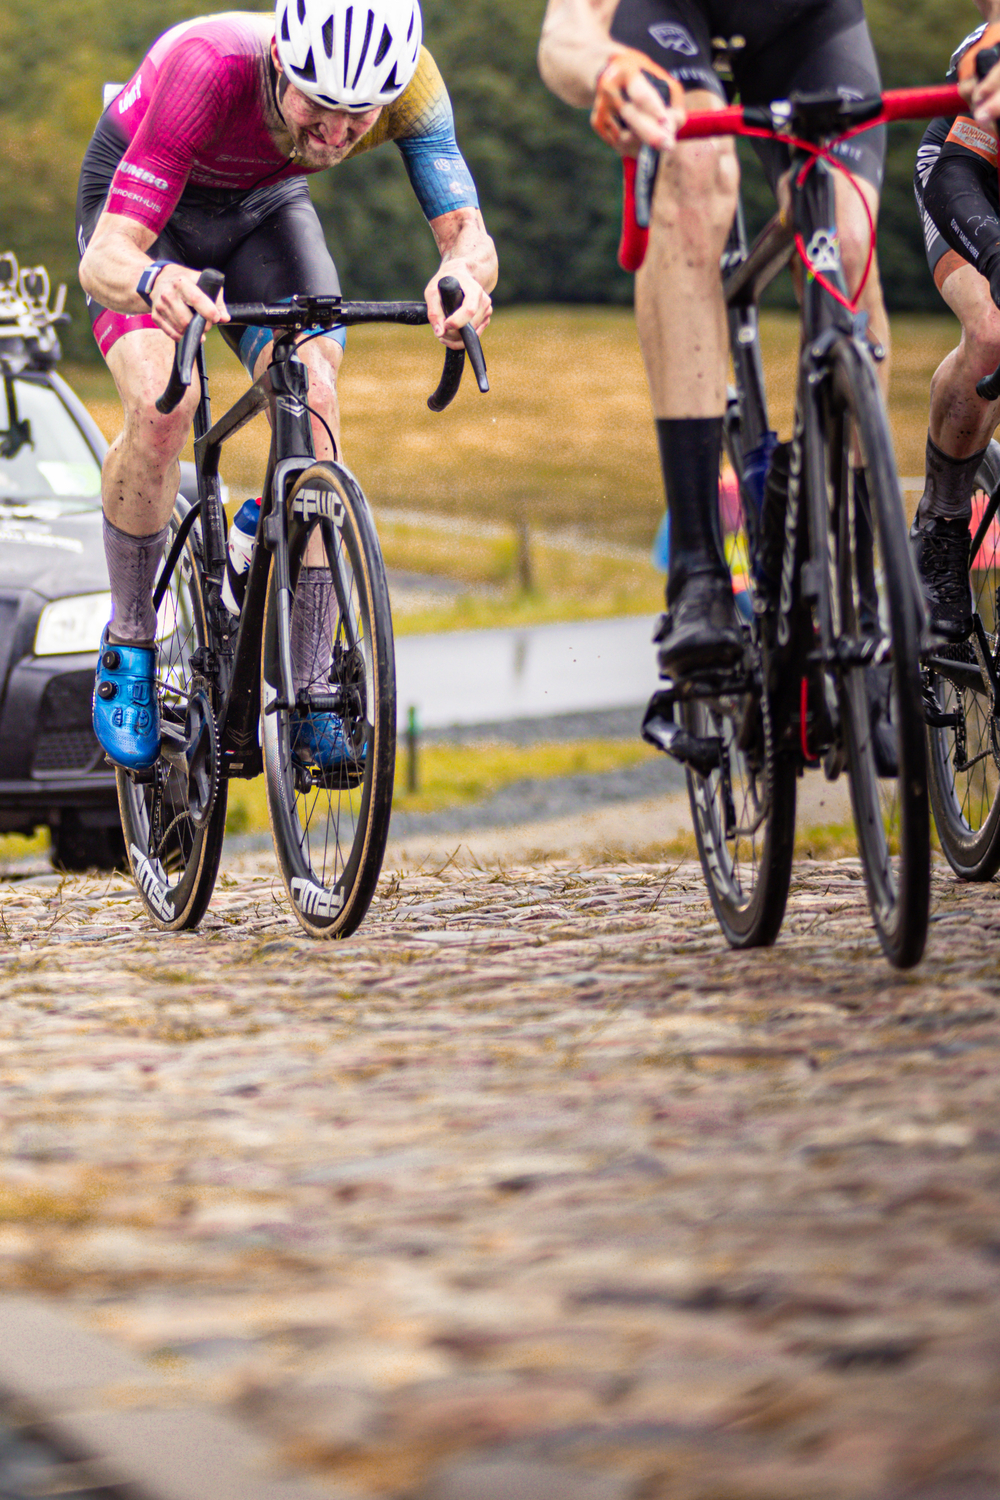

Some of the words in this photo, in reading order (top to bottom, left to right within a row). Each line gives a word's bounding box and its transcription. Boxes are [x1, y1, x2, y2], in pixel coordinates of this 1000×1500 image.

[111, 187, 162, 214] BROEKHUIS
[290, 488, 346, 527] FFWD
[290, 876, 345, 919] FFWD
